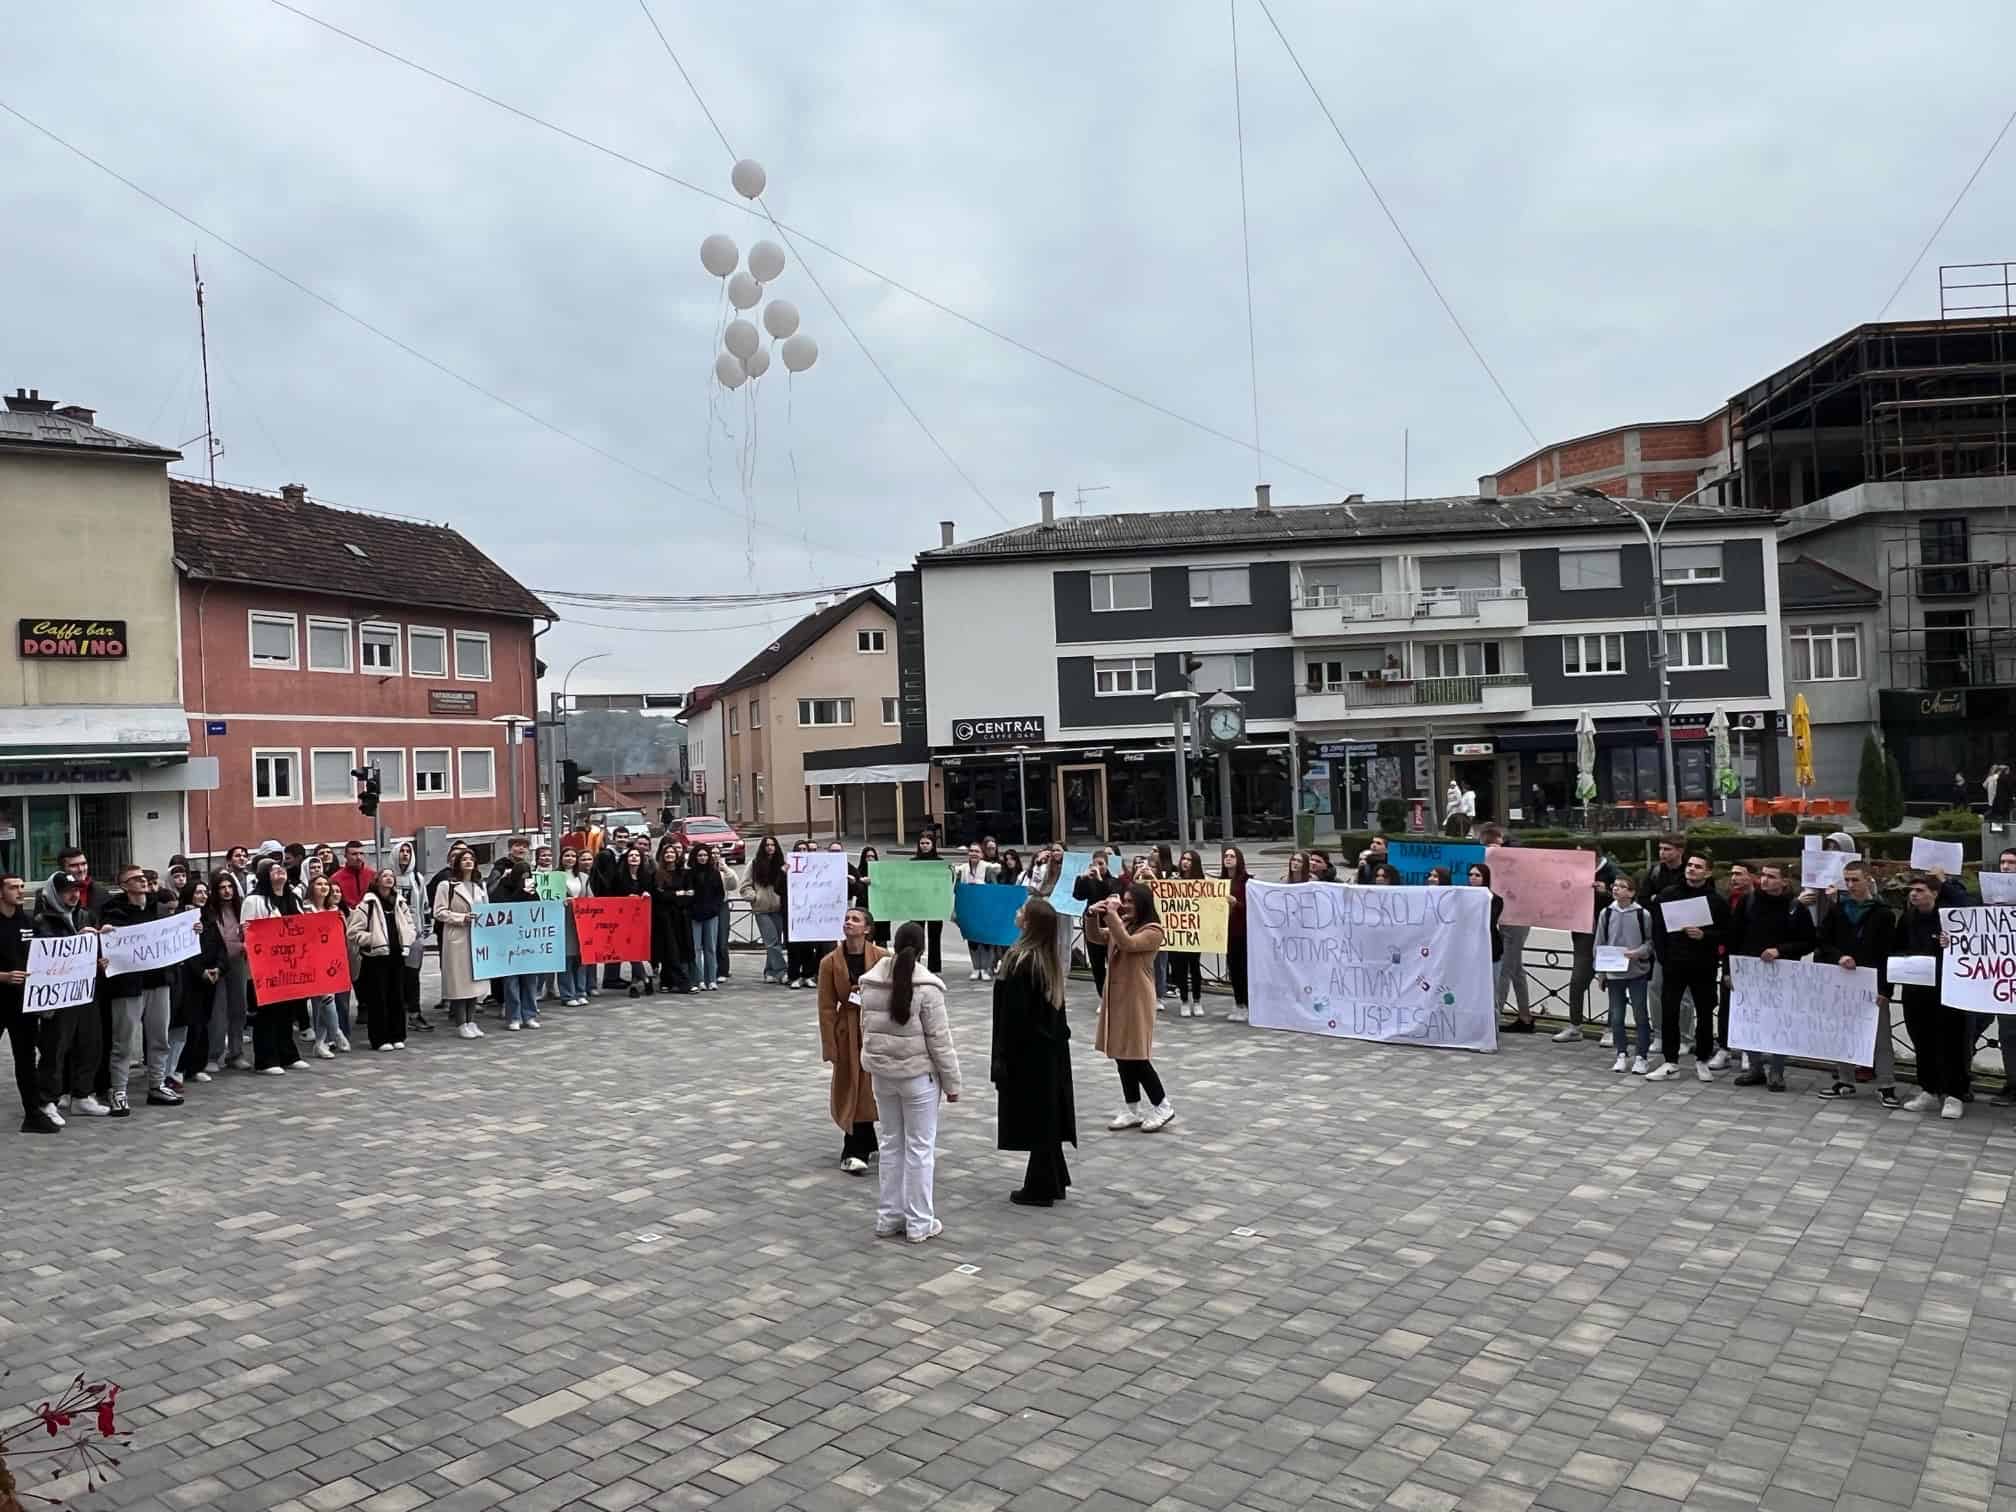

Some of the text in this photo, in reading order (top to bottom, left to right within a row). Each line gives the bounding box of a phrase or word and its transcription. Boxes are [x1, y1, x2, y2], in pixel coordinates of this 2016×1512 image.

[33, 620, 115, 639] Caffe bar
[24, 639, 125, 656] DOMINO
[975, 719, 1042, 735] CENTRAL
[1151, 879, 1227, 898] REDNJOŠKOLCI
[1161, 899, 1200, 912] DANAS
[473, 906, 546, 929] KADA VI
[1161, 914, 1200, 930] IDERI
[1948, 909, 1978, 933] SVI
[475, 944, 489, 962] MI
[1954, 956, 2016, 979] SAMO
[1329, 966, 1403, 997] AKTIVAN
